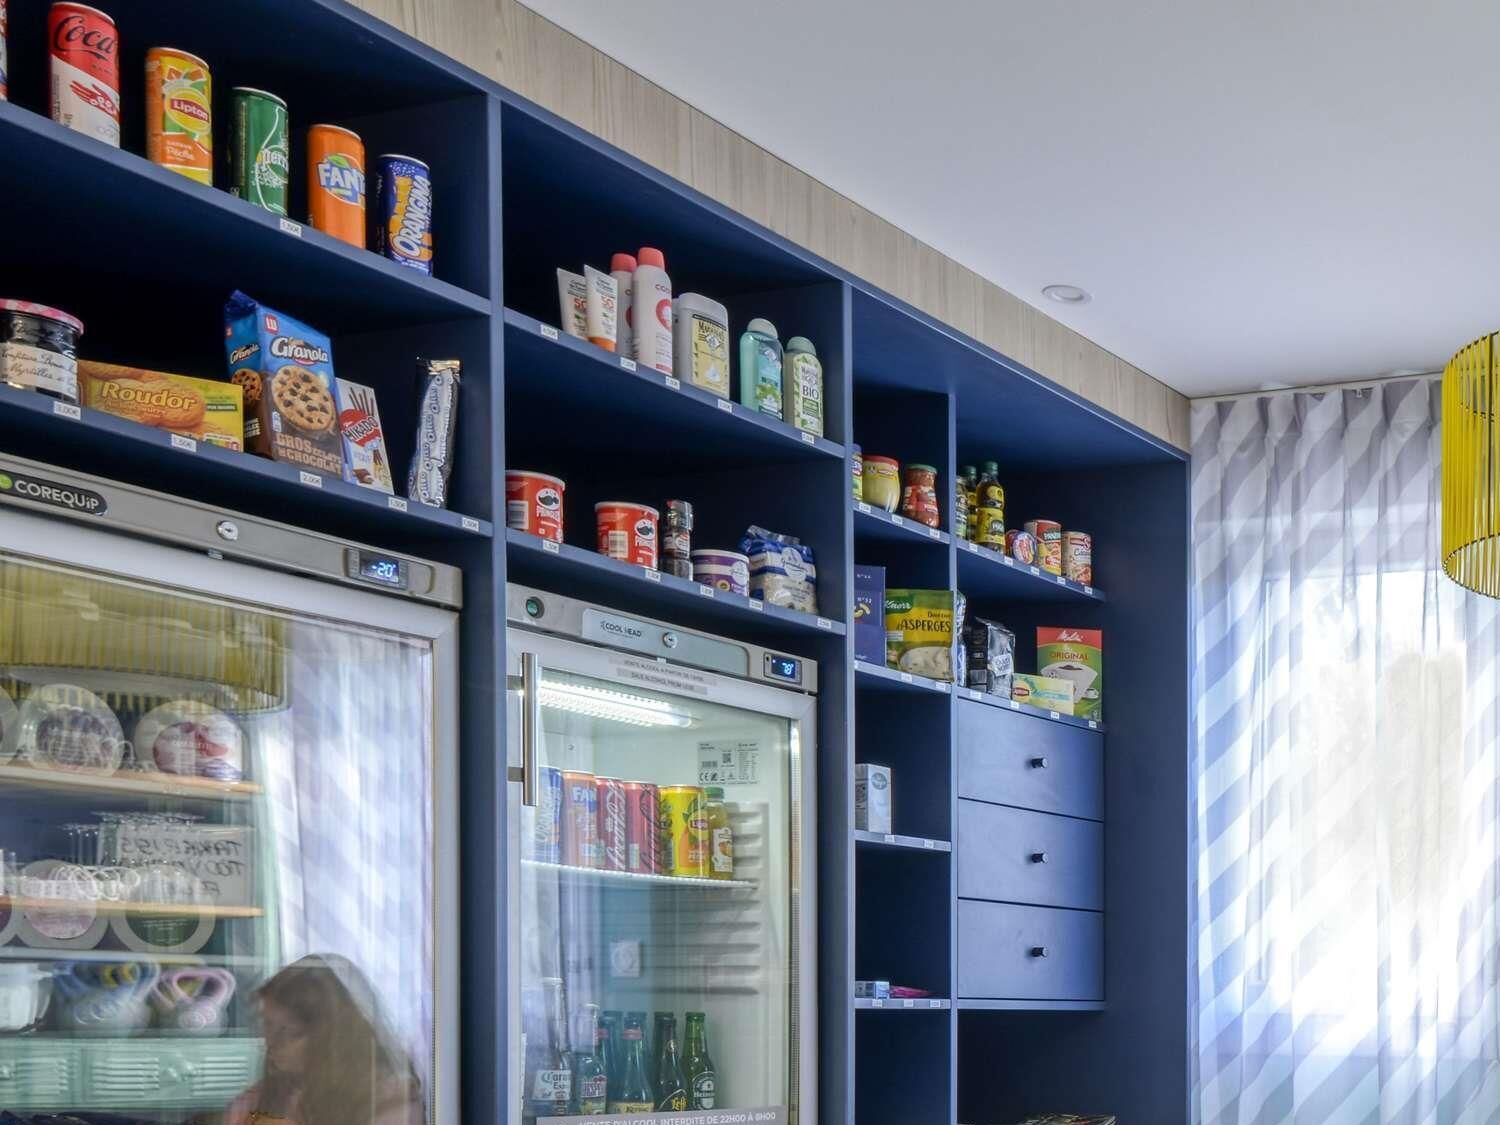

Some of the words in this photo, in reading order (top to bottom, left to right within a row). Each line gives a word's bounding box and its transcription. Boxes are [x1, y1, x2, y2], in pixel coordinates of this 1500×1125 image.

[171, 99, 209, 121] Lipton
[271, 335, 328, 363] Granola
[101, 381, 196, 410] Roudor
[802, 385, 819, 400] BIO
[707, 1115, 718, 1124] DE
